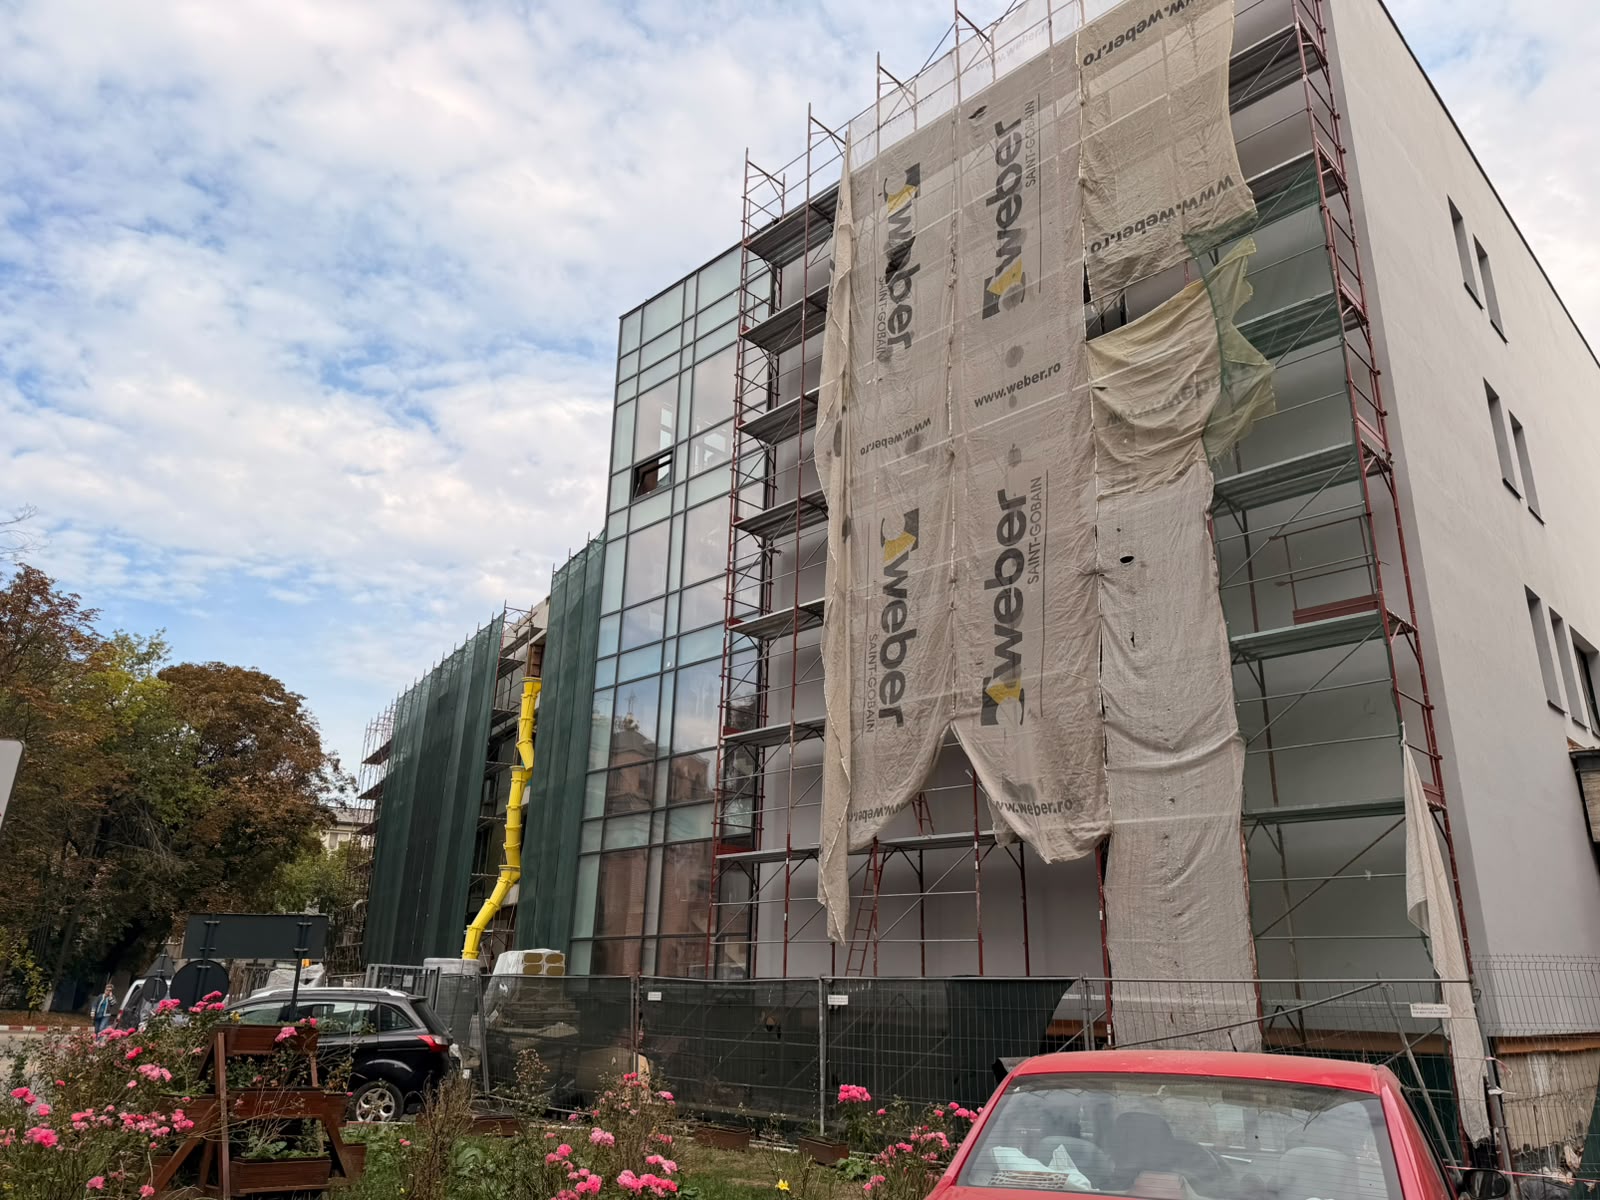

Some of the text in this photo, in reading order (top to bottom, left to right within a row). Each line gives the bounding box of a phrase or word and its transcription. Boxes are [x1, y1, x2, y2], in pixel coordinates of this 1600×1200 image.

[1083, 0, 1194, 66] w.weber.ro
[1025, 100, 1036, 188] SAINT-GOBAIN
[986, 118, 1023, 278] weber
[1091, 175, 1234, 253] www.weber.ro
[876, 276, 887, 360] SAINT-GOBAIN
[887, 200, 921, 350] wber
[974, 362, 1061, 408] www.weber.ro
[860, 417, 932, 456] www.weber.ro
[1028, 476, 1042, 585] SAINT-GOBAIN
[984, 489, 1027, 679] weber
[866, 634, 878, 733] SAINT-GOBAIN
[879, 551, 917, 728] weber
[993, 798, 1073, 817] ww.weber.ro
